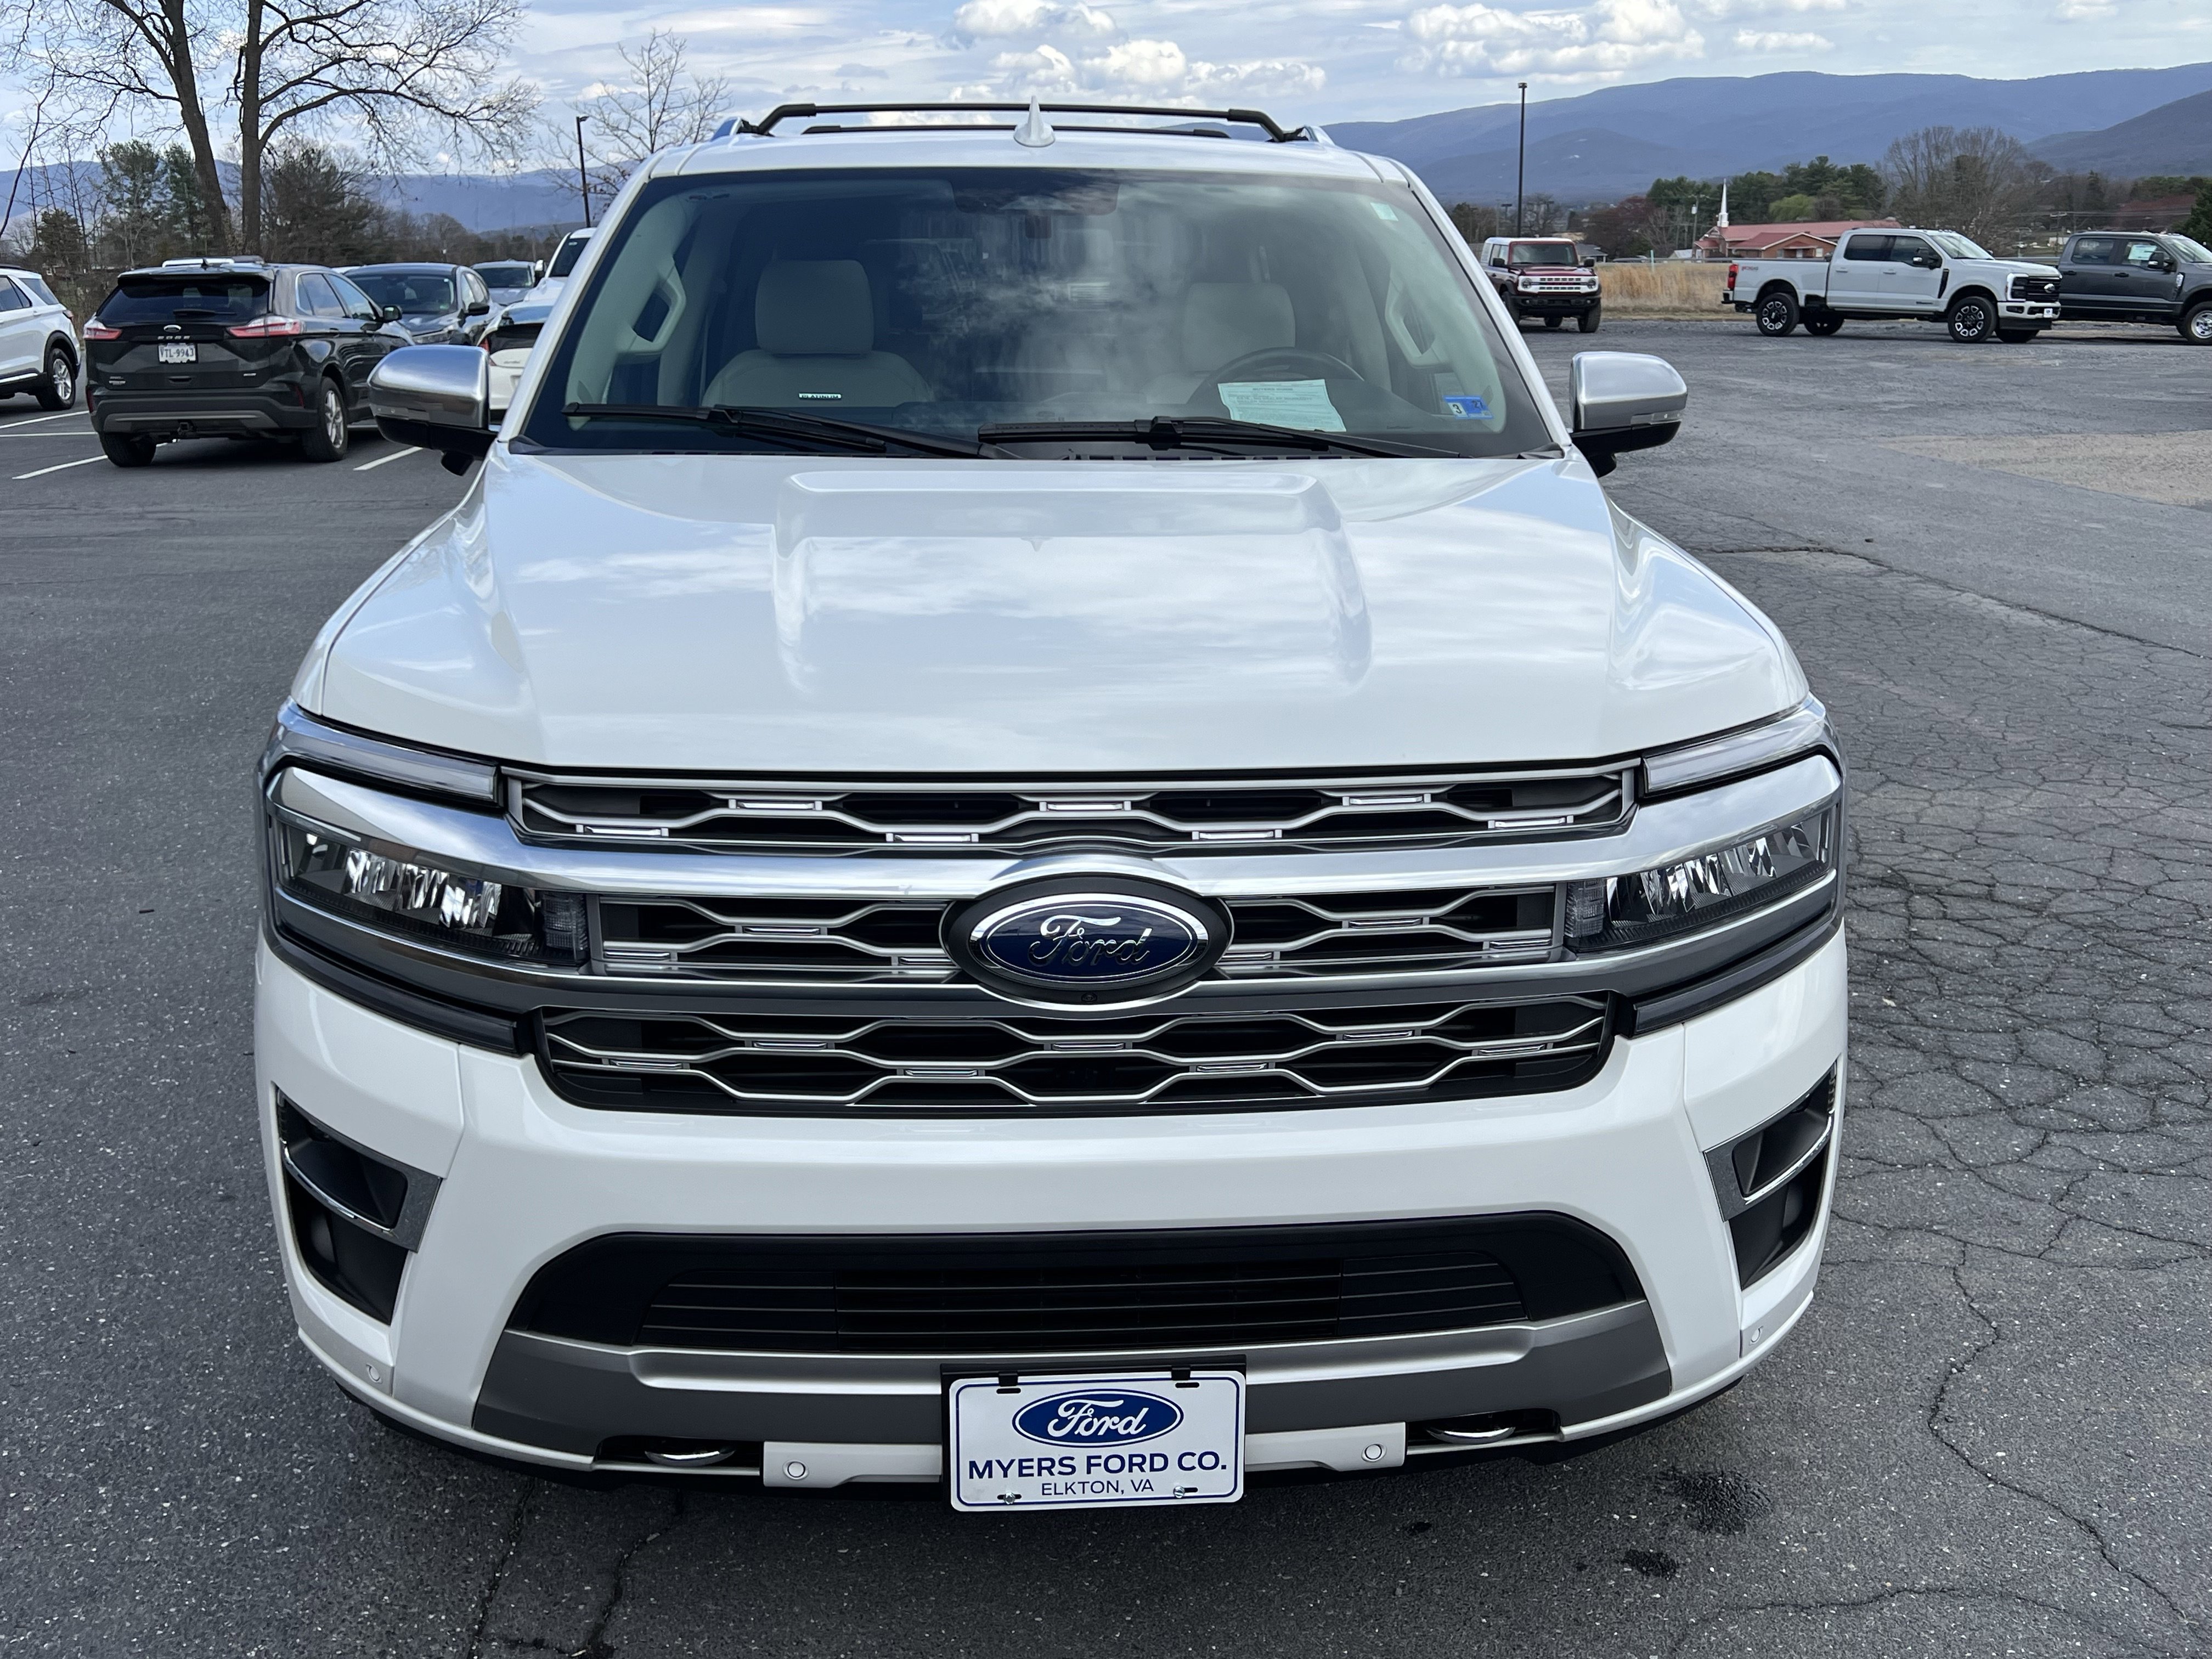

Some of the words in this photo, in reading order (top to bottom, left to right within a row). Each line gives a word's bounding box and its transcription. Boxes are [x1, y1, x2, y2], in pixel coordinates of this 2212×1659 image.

[1453, 404, 1462, 414] 3
[1028, 915, 1152, 967] Ford
[1047, 1399, 1149, 1437] Ford
[969, 1456, 1076, 1480] MYERS
[1086, 1453, 1169, 1475] FORD
[1177, 1451, 1227, 1471] CO.
[1042, 1480, 1125, 1496] ELKTON,
[1130, 1479, 1154, 1492] VA
